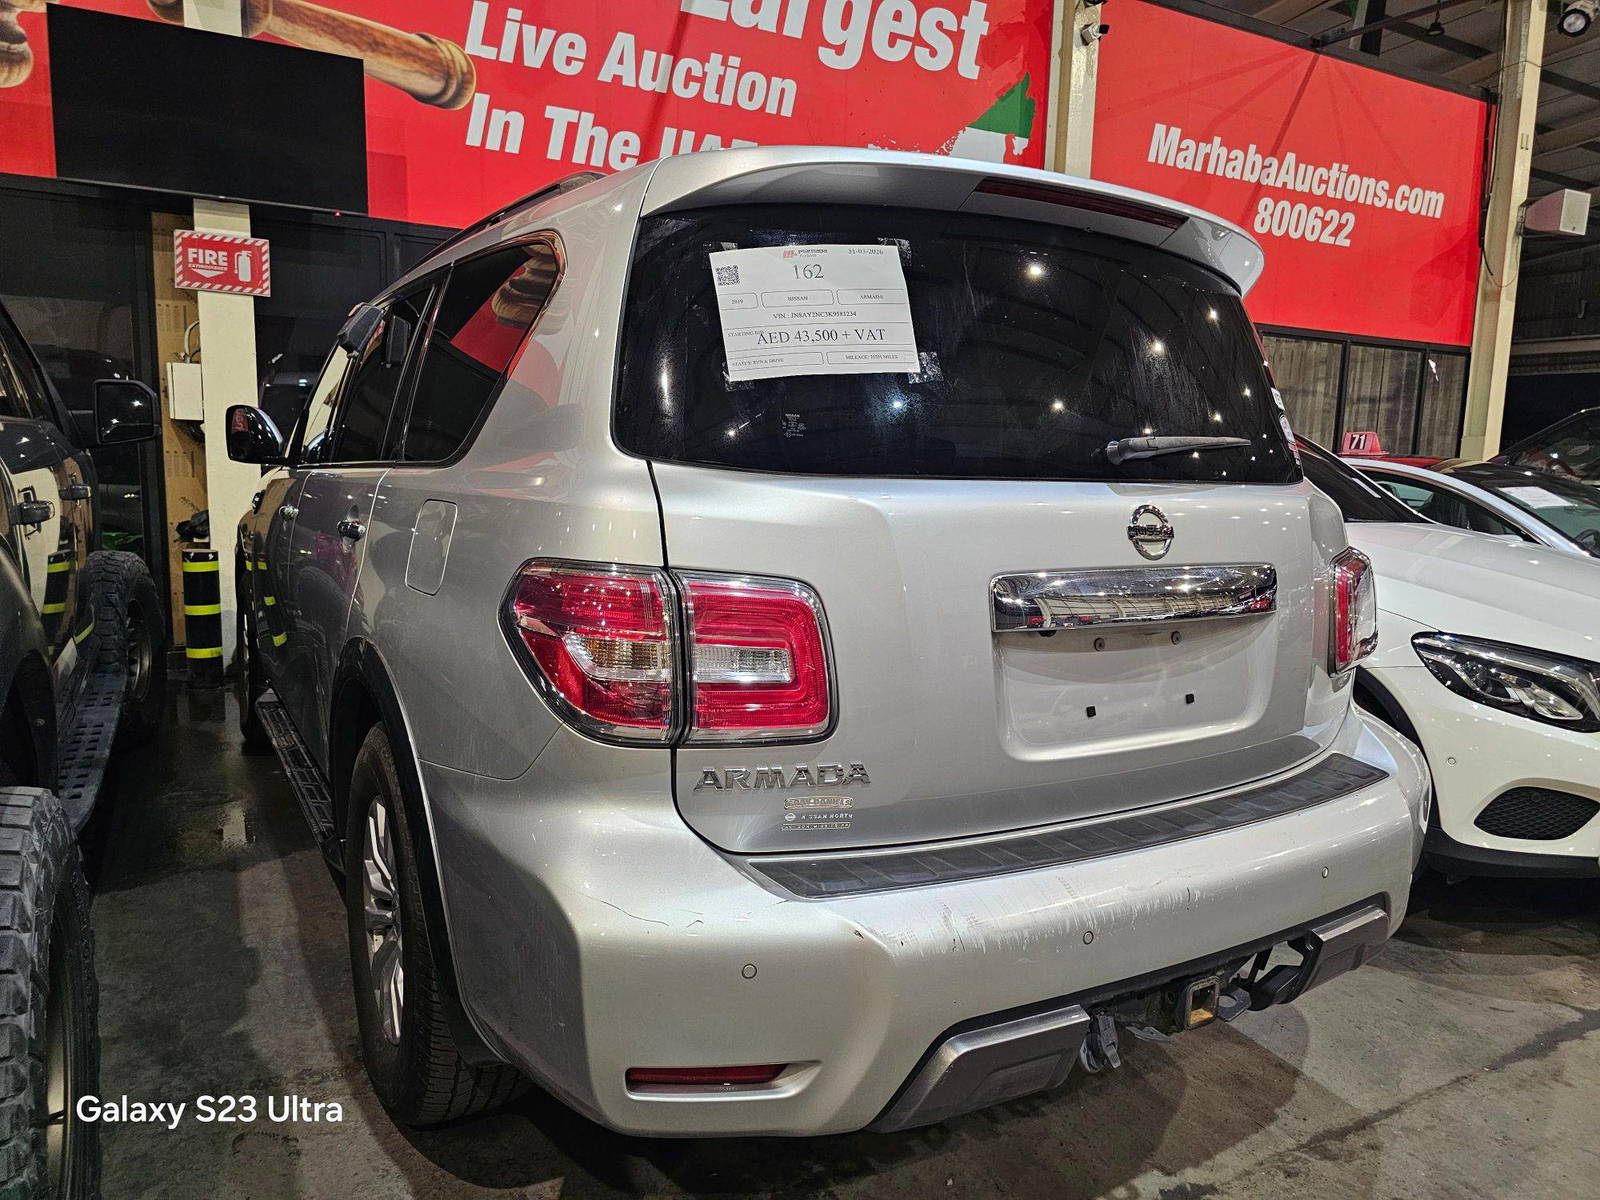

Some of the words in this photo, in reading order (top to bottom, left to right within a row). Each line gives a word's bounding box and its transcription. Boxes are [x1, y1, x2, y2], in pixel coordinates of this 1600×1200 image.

[464, 0, 587, 76] Live
[597, 32, 797, 118] Auction
[680, 0, 989, 80] argest
[465, 93, 525, 154] In
[544, 105, 641, 171] The
[1147, 123, 1445, 219] MarhabaAuctions.com
[1253, 197, 1355, 247] 800622
[187, 247, 228, 266] FIRE
[793, 263, 824, 279] 162
[757, 331, 790, 345] AED
[793, 329, 838, 343] 43,500
[841, 330, 851, 339] +
[854, 328, 886, 340] VAT
[1350, 434, 1366, 450] 71
[693, 760, 872, 791] ARMADA
